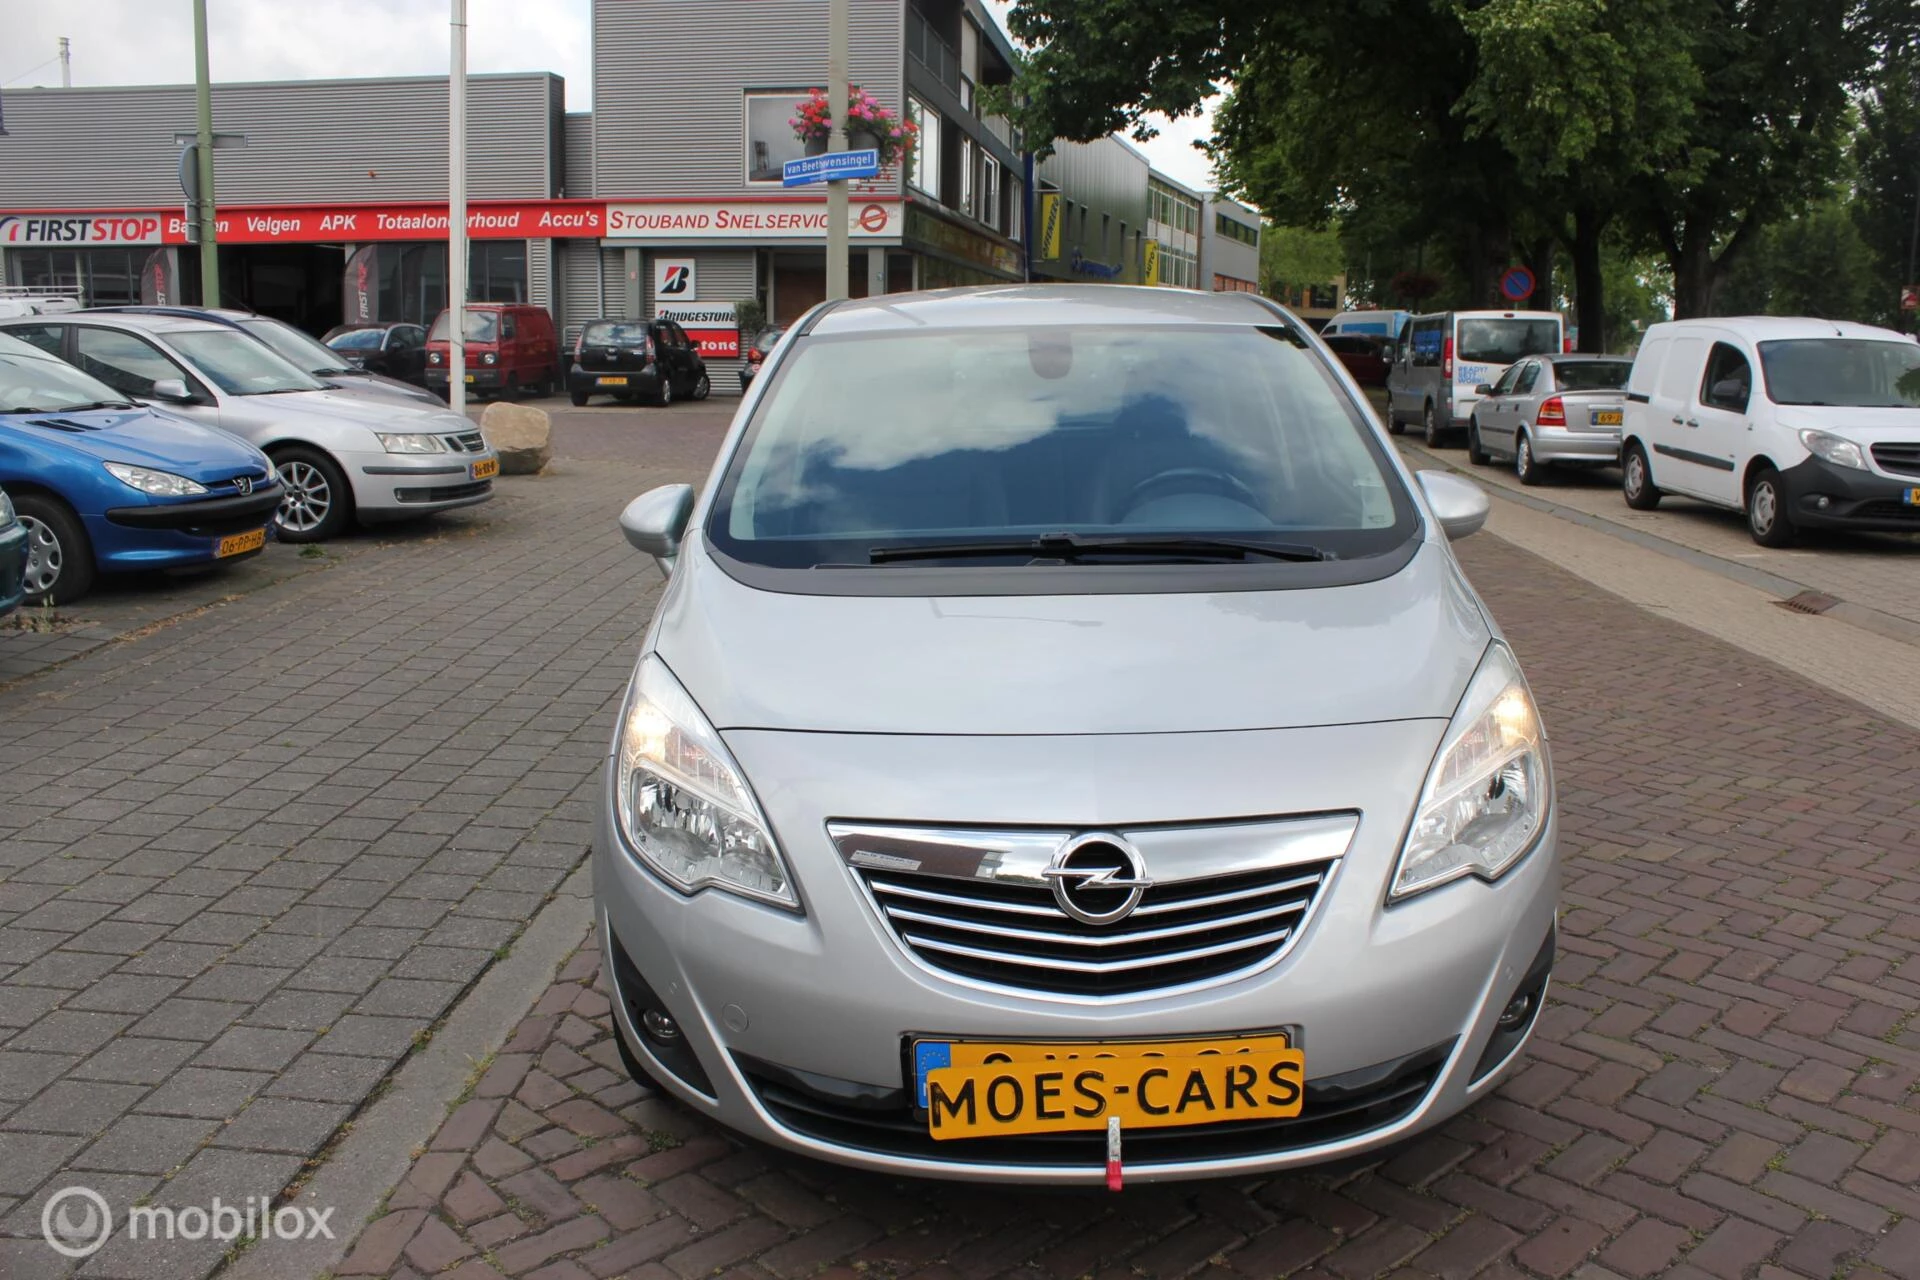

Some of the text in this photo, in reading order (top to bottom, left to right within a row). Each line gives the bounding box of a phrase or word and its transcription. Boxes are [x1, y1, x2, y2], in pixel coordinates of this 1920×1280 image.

[787, 165, 801, 174] van
[247, 216, 300, 235] Velgen
[319, 214, 357, 230] APK
[538, 211, 599, 227] Accu's
[658, 309, 736, 322] BRIDGESTONE
[929, 1061, 1301, 1128] MOES-CARS
